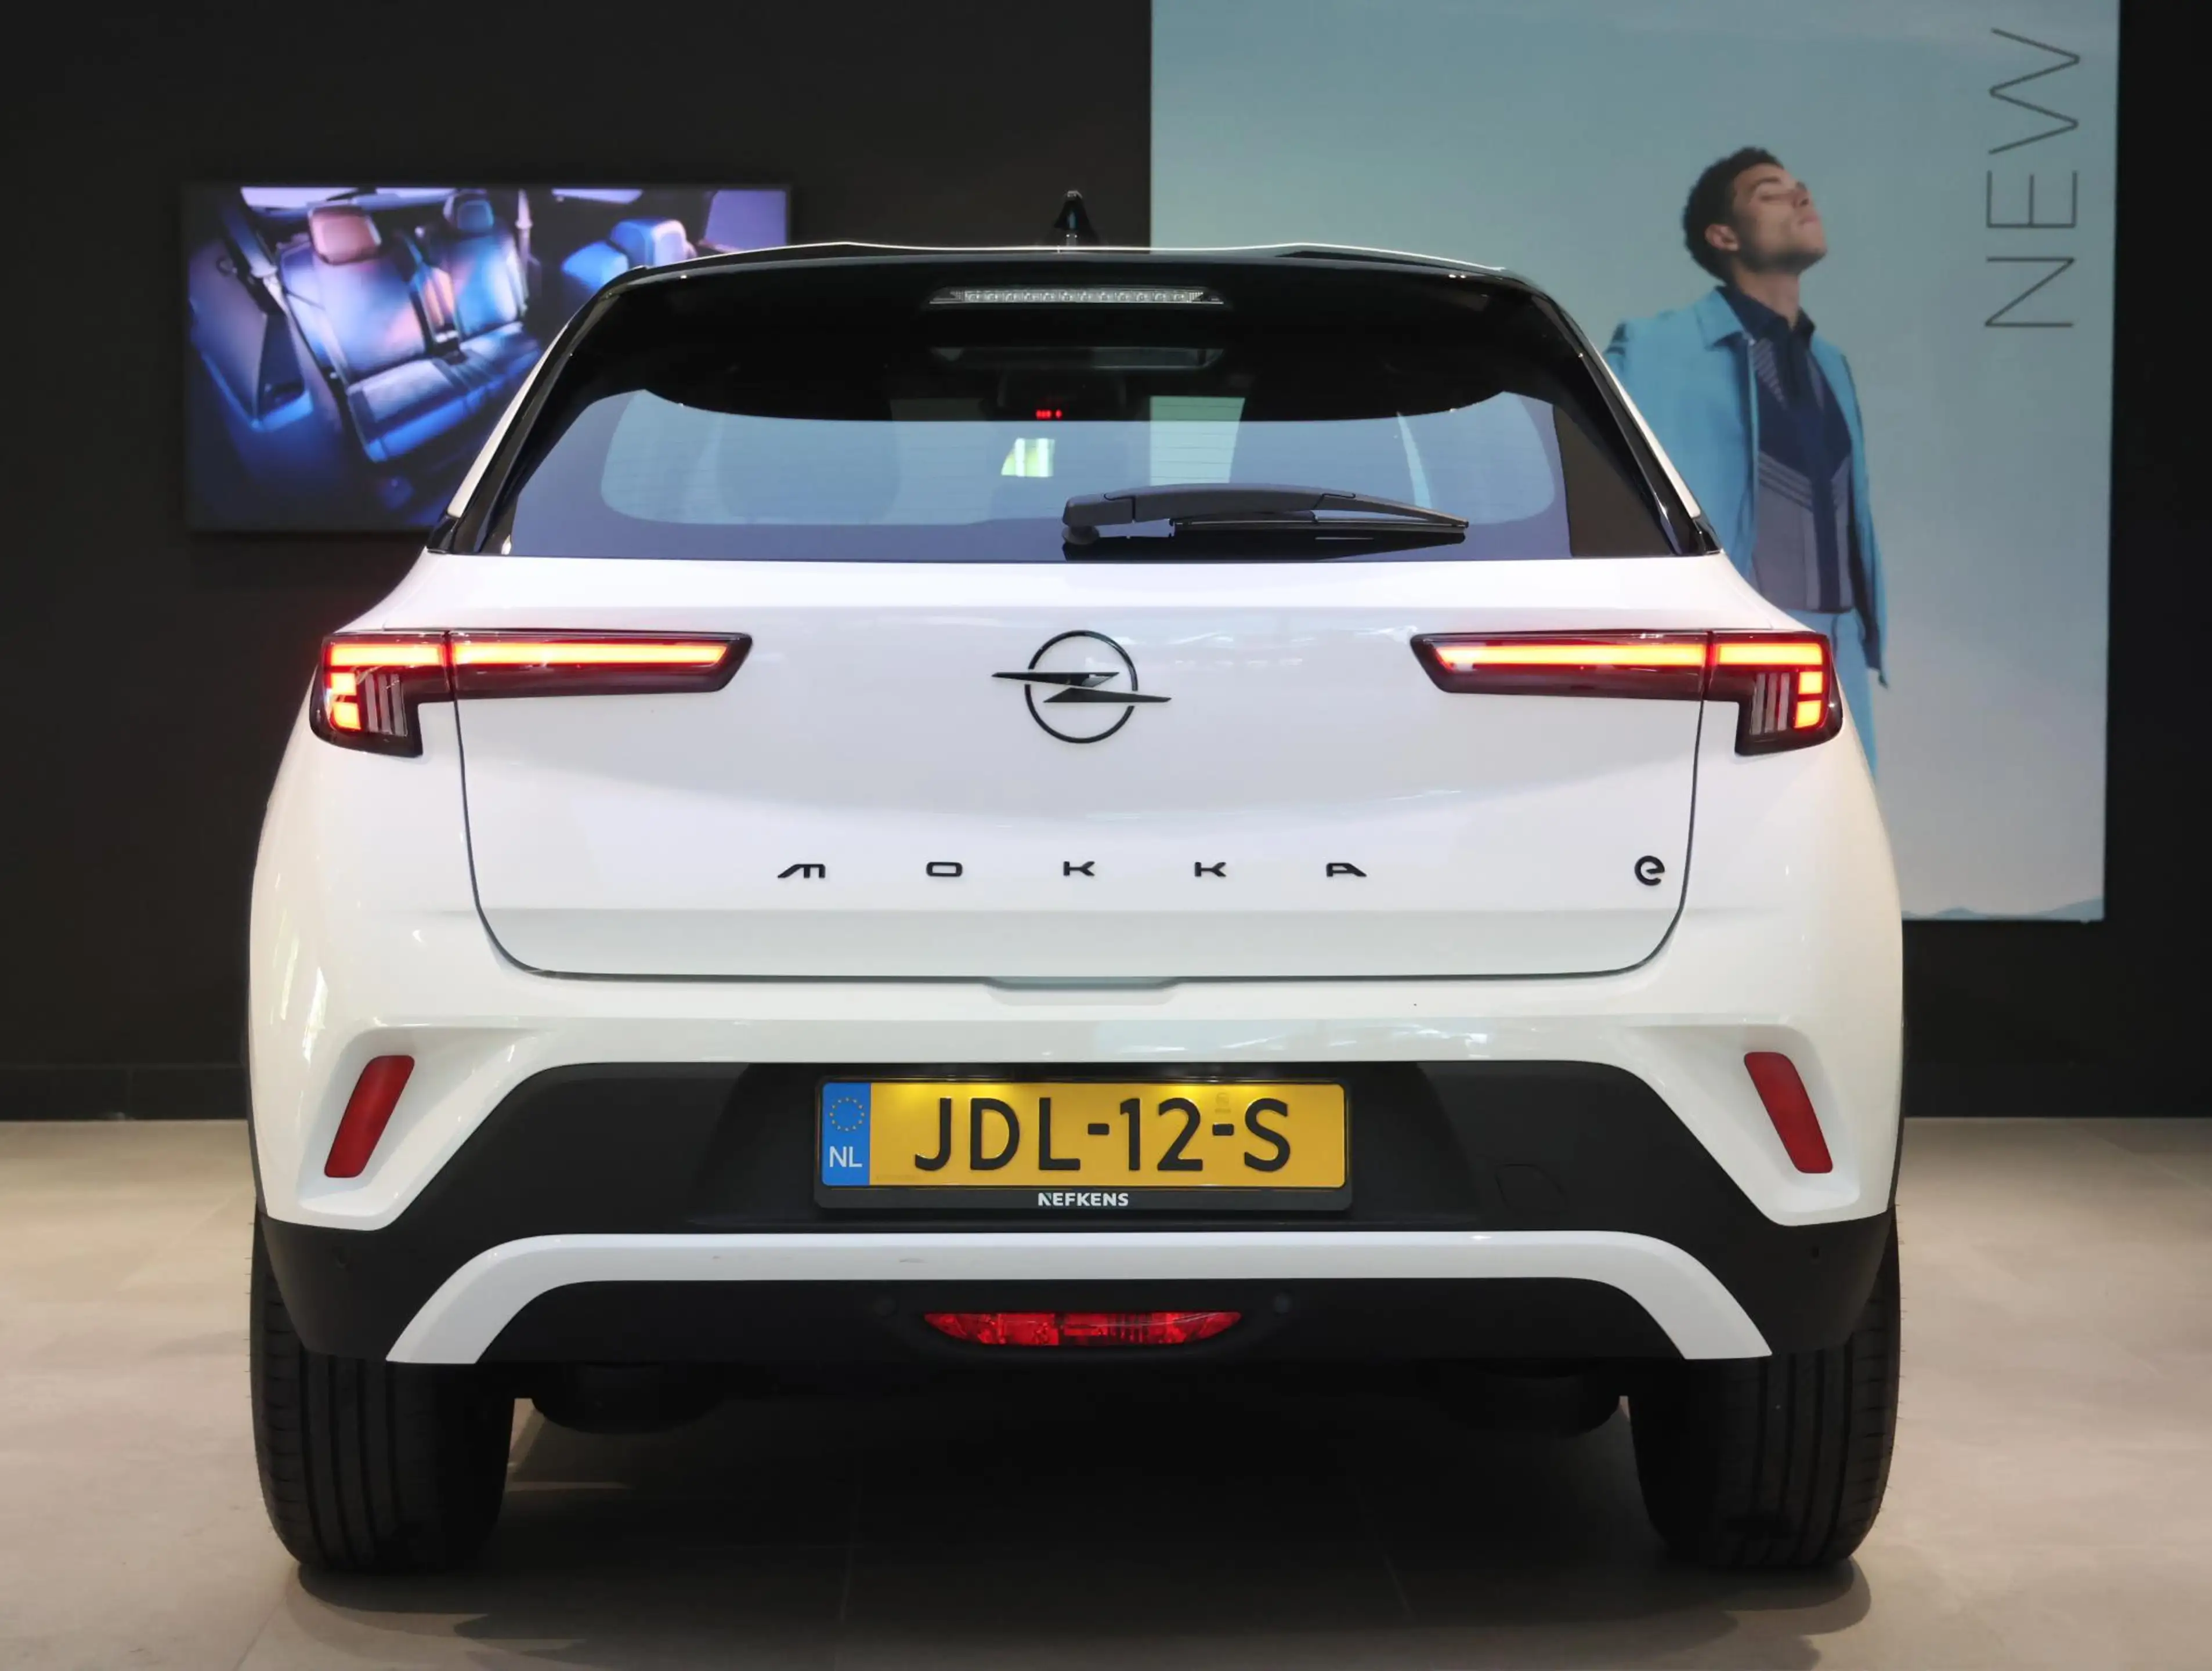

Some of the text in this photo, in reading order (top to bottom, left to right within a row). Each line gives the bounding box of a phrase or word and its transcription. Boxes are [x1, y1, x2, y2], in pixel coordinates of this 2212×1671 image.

[1985, 28, 2081, 328] NEW
[777, 861, 1367, 878] MOKKA
[1634, 855, 1666, 886] e
[915, 1097, 1291, 1172] JDL-12-S
[829, 1145, 863, 1168] NL
[1038, 1192, 1129, 1207] NEFKENS
